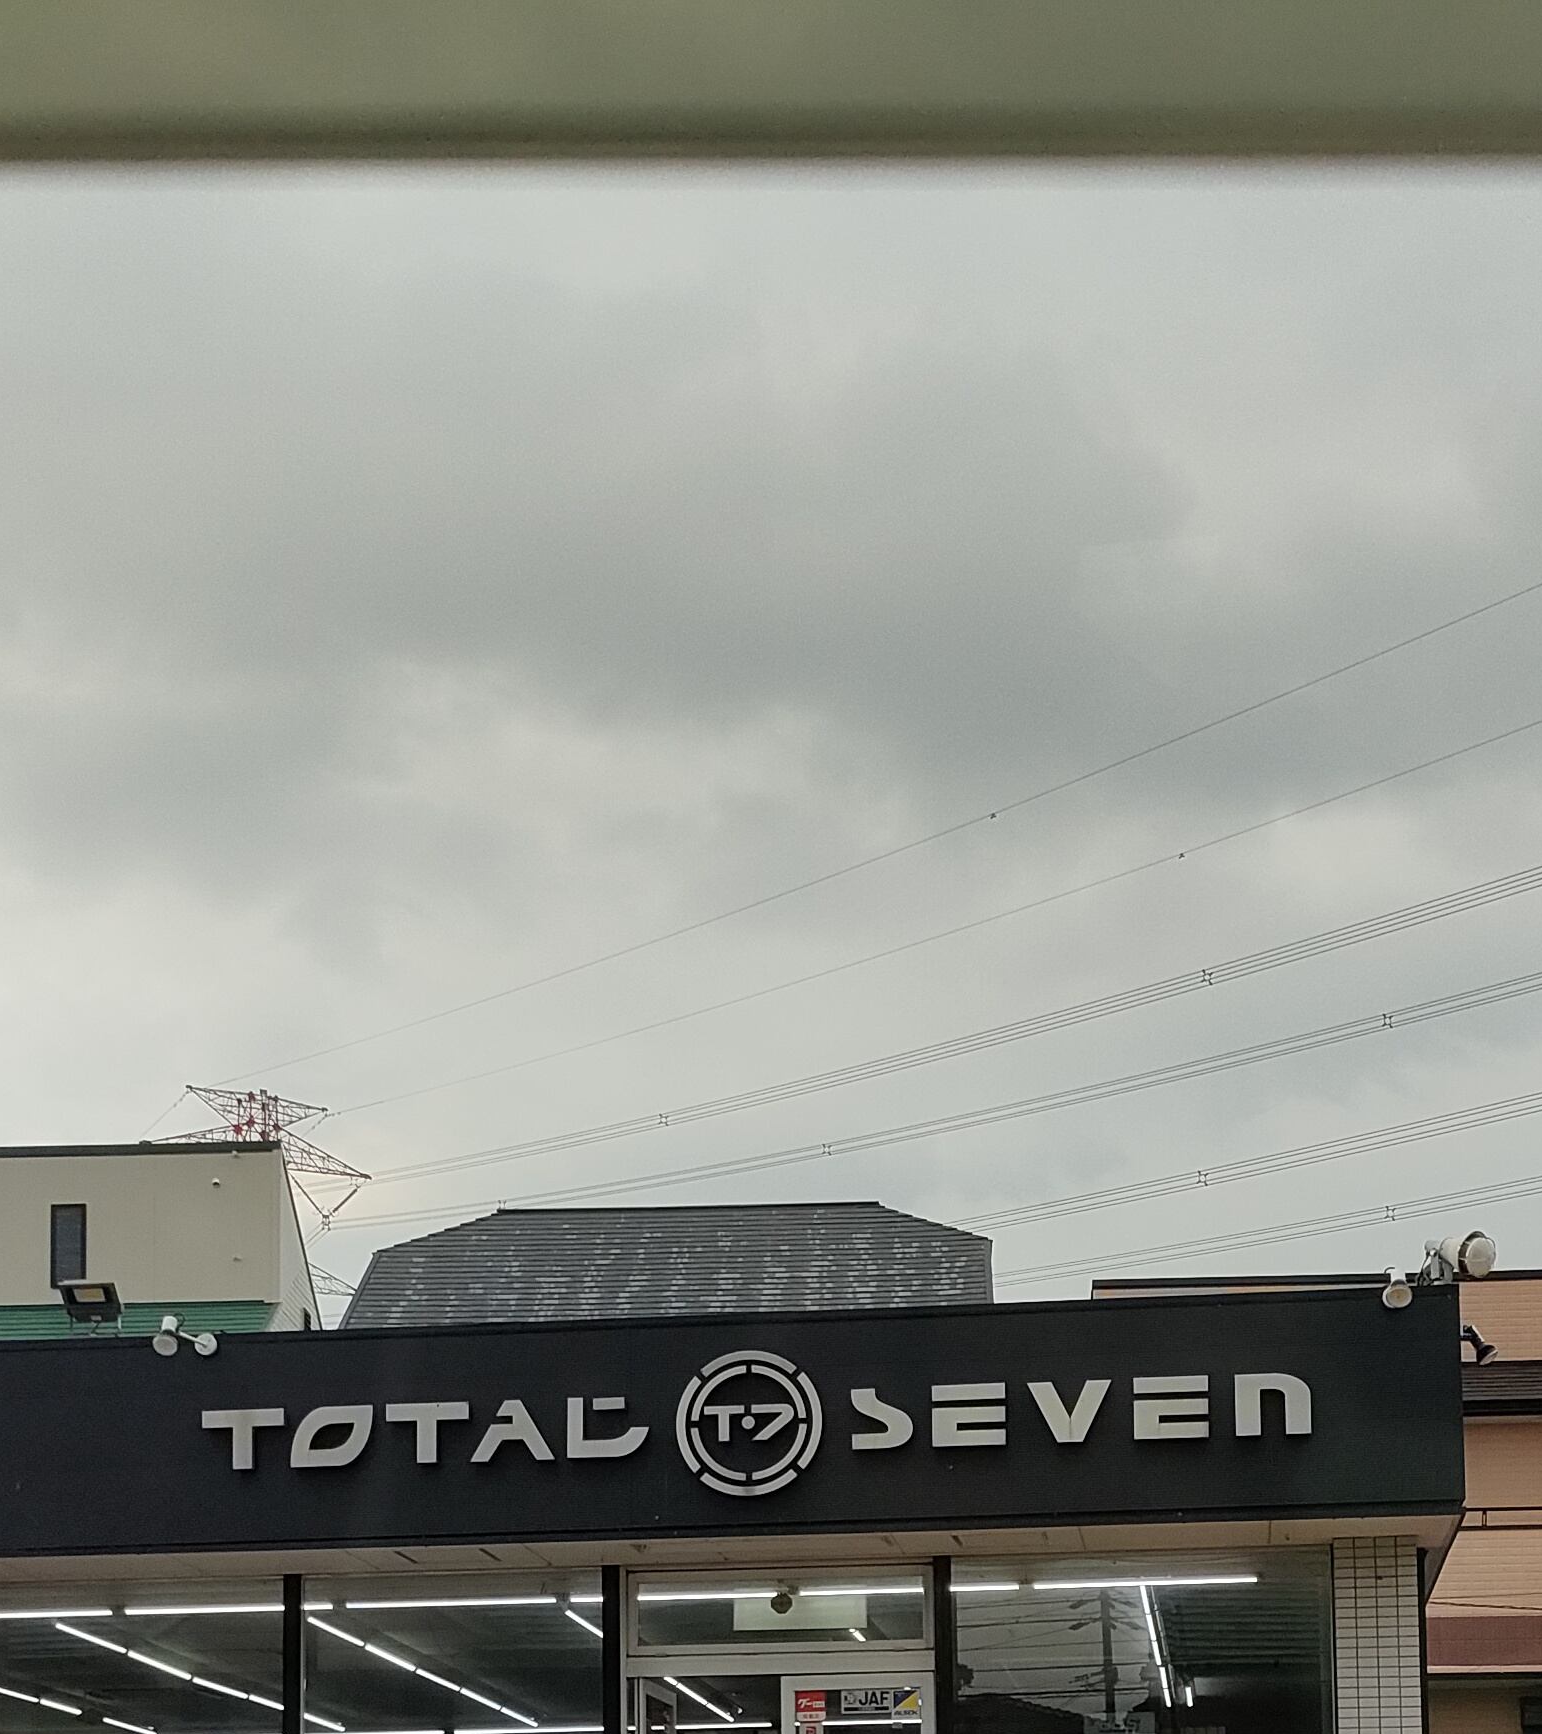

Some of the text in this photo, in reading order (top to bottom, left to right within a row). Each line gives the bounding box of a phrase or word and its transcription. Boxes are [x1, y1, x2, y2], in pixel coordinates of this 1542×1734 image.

[201, 1396, 650, 1471] TOTAL
[849, 1372, 1312, 1451] SEVEN
[858, 1690, 890, 1706] JAF
